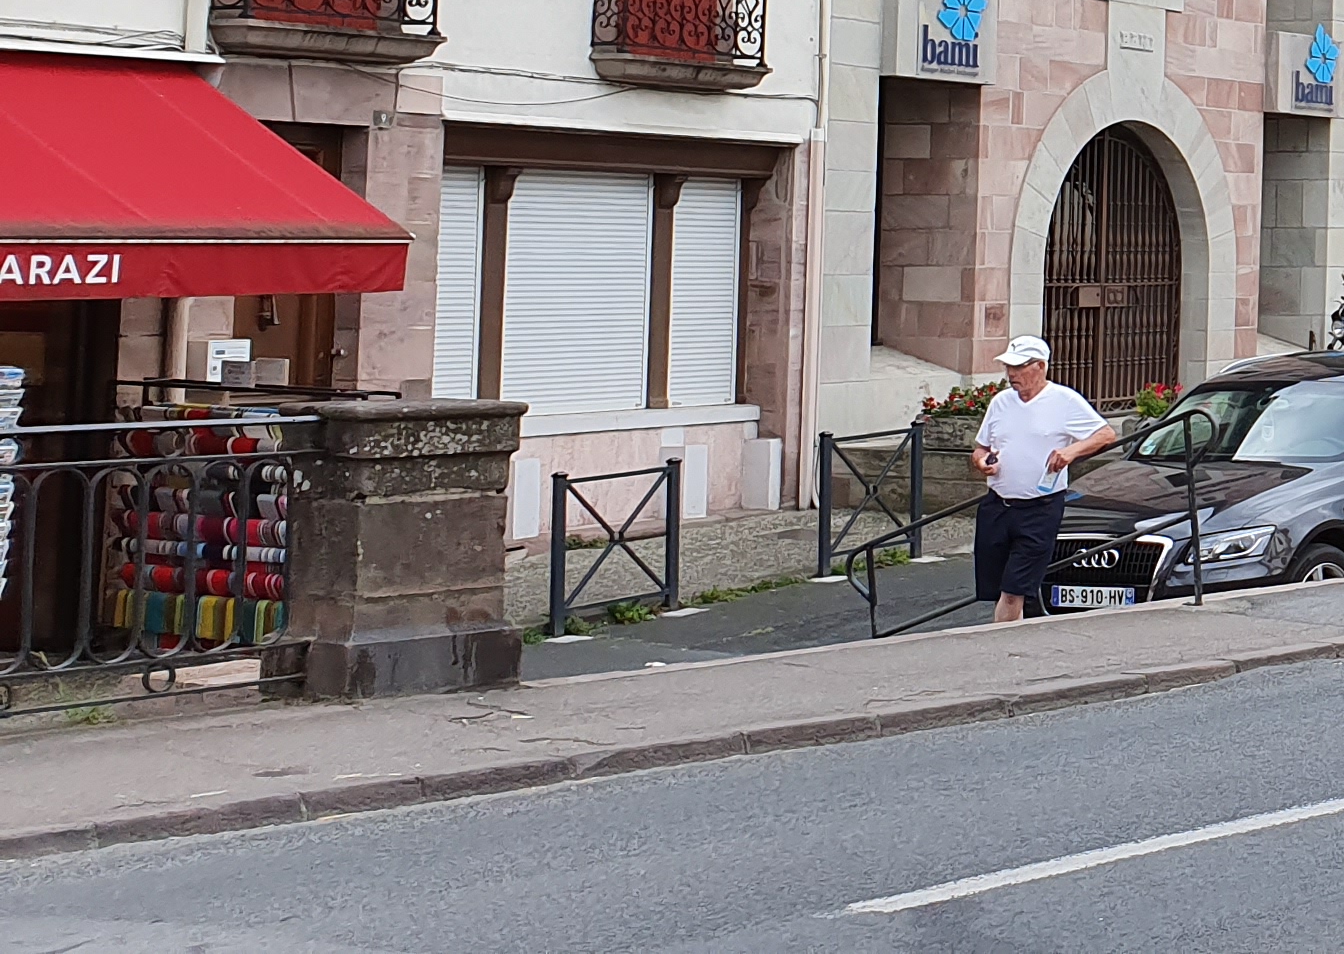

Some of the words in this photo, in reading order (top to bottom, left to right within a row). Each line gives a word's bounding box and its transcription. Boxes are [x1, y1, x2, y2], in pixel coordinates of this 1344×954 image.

[922, 24, 979, 68] bami
[1295, 70, 1334, 106] bami
[1060, 587, 1125, 606] BS-910-HV
